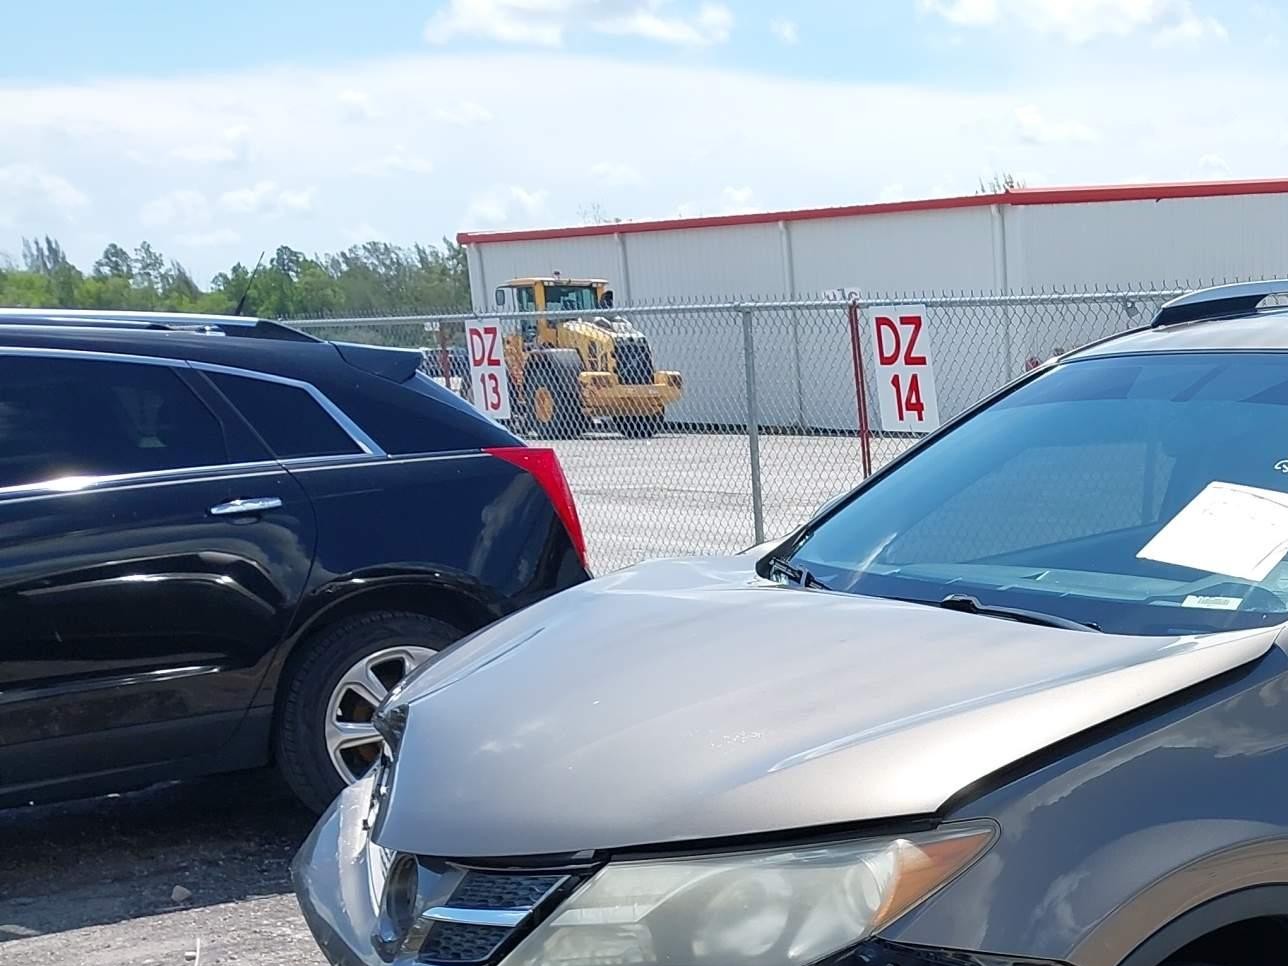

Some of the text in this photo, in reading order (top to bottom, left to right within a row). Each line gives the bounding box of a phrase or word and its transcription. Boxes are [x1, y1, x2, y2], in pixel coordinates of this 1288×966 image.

[468, 326, 501, 366] DZ
[875, 315, 927, 366] DZ
[480, 372, 502, 411] 13
[890, 373, 924, 421] 14
